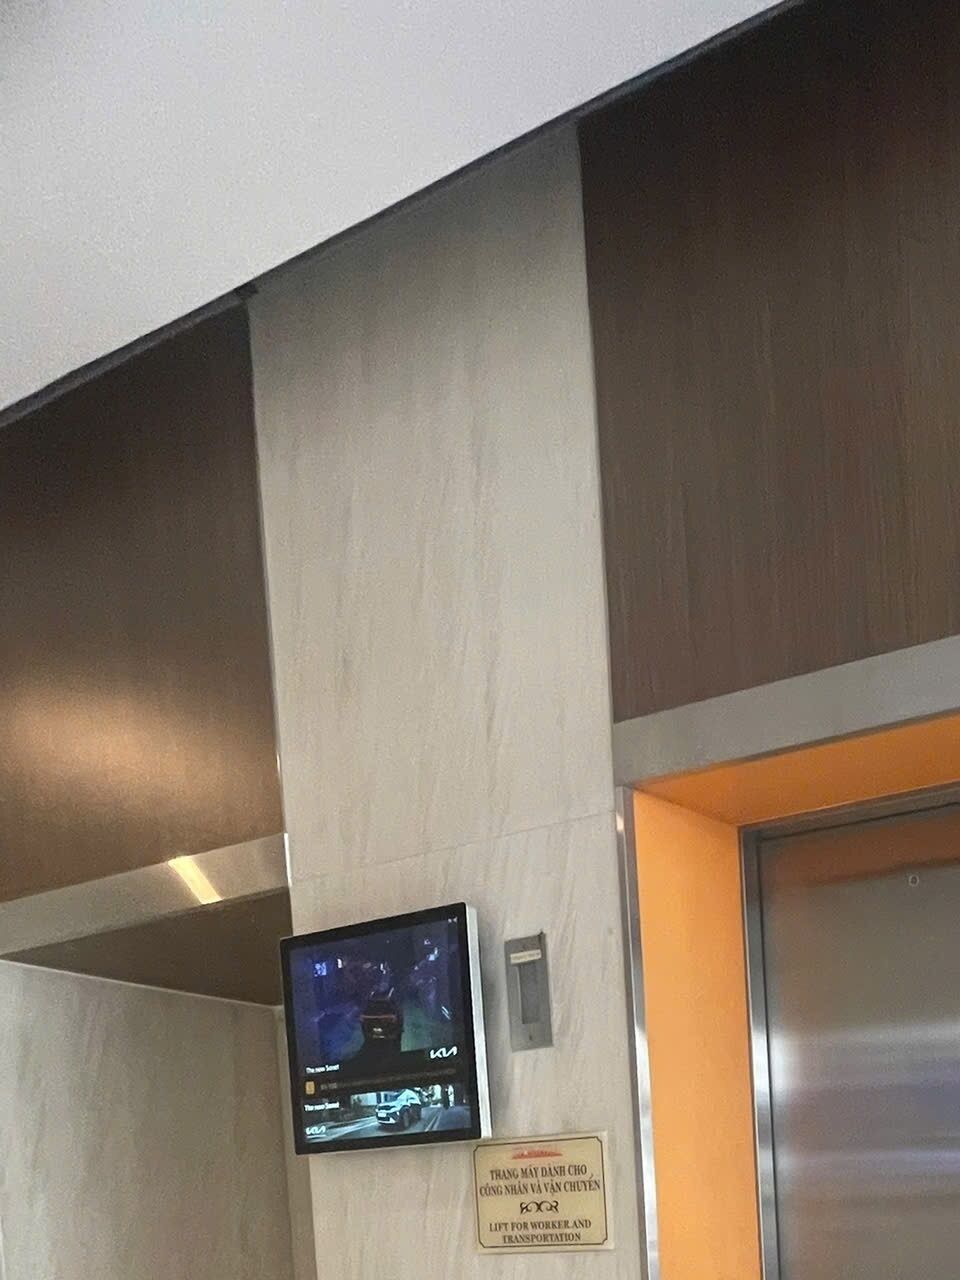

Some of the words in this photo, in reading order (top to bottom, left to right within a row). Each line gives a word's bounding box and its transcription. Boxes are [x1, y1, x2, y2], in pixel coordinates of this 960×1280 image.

[490, 1169, 519, 1181] THANG
[568, 1164, 588, 1177] CHO
[489, 1222, 508, 1232] LIFT
[511, 1221, 529, 1231] FOR
[531, 1220, 570, 1231] WORKER
[571, 1219, 592, 1229] AND
[503, 1232, 581, 1244] TRANSPORTATION
